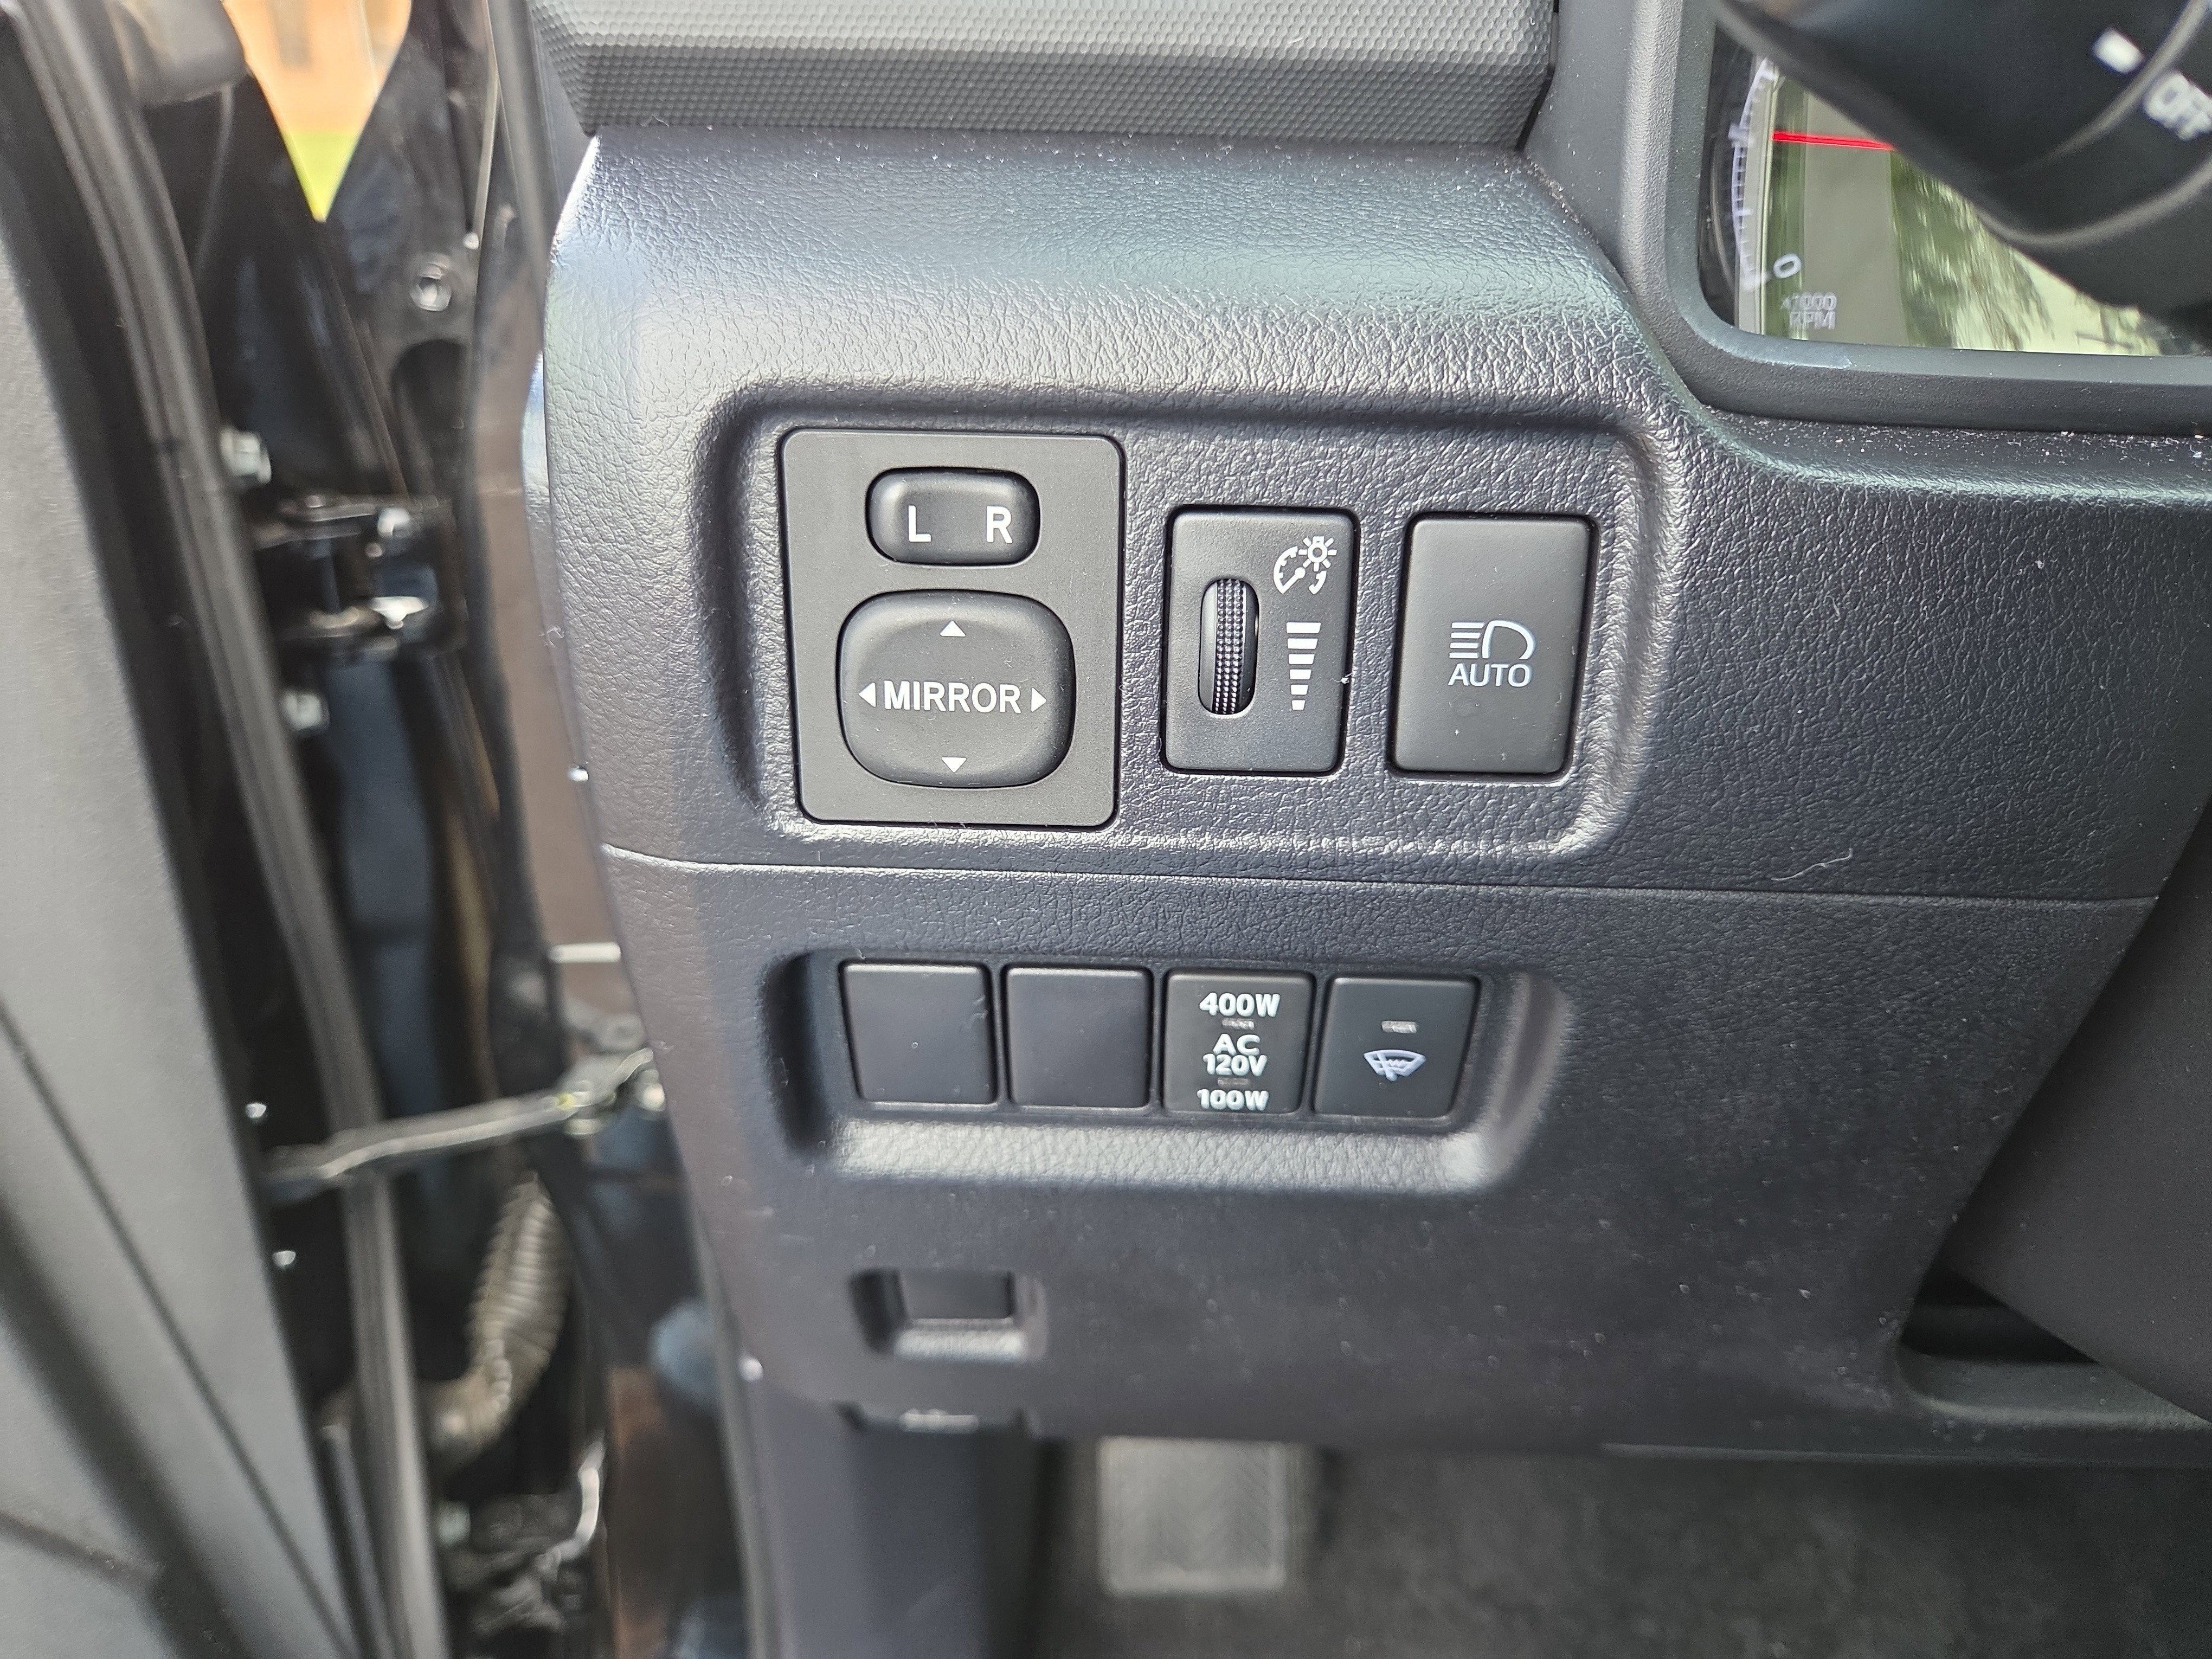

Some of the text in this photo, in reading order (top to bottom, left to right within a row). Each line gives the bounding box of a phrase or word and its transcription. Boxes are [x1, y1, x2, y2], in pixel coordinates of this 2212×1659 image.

[1773, 253, 1802, 279] 0
[1790, 310, 1835, 330] RPM
[908, 505, 1013, 544] L R
[1448, 663, 1532, 688] AUTO
[883, 680, 1021, 714] MIRROR
[1199, 992, 1281, 1018] 400W
[1212, 1033, 1261, 1056] AC
[1203, 1053, 1268, 1077] 120V
[1196, 1089, 1270, 1111] 100W
